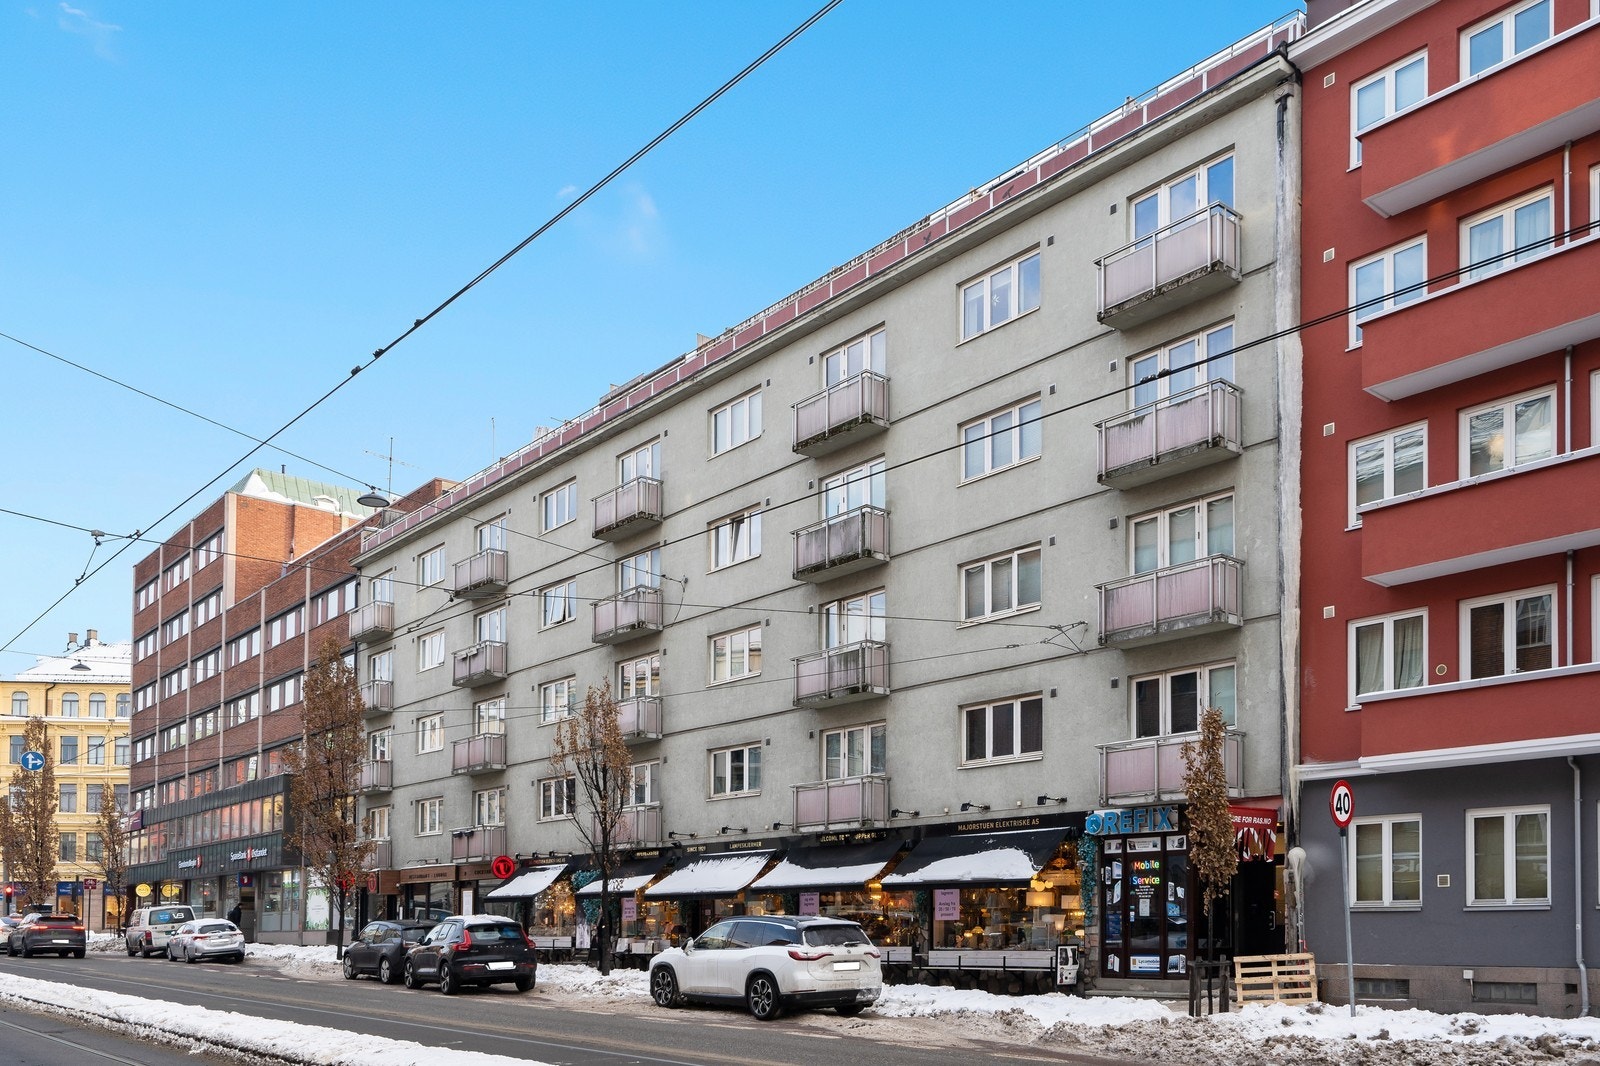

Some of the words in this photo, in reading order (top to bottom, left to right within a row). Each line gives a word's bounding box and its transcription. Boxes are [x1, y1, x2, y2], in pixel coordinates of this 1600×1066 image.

[1335, 792, 1350, 815] 40
[958, 822, 994, 831] MAJORSTUEN
[995, 819, 1030, 828] ELEKTRISKE
[1104, 806, 1171, 834] REFIX
[1133, 860, 1160, 870] Mobile
[1132, 875, 1160, 885] Service
